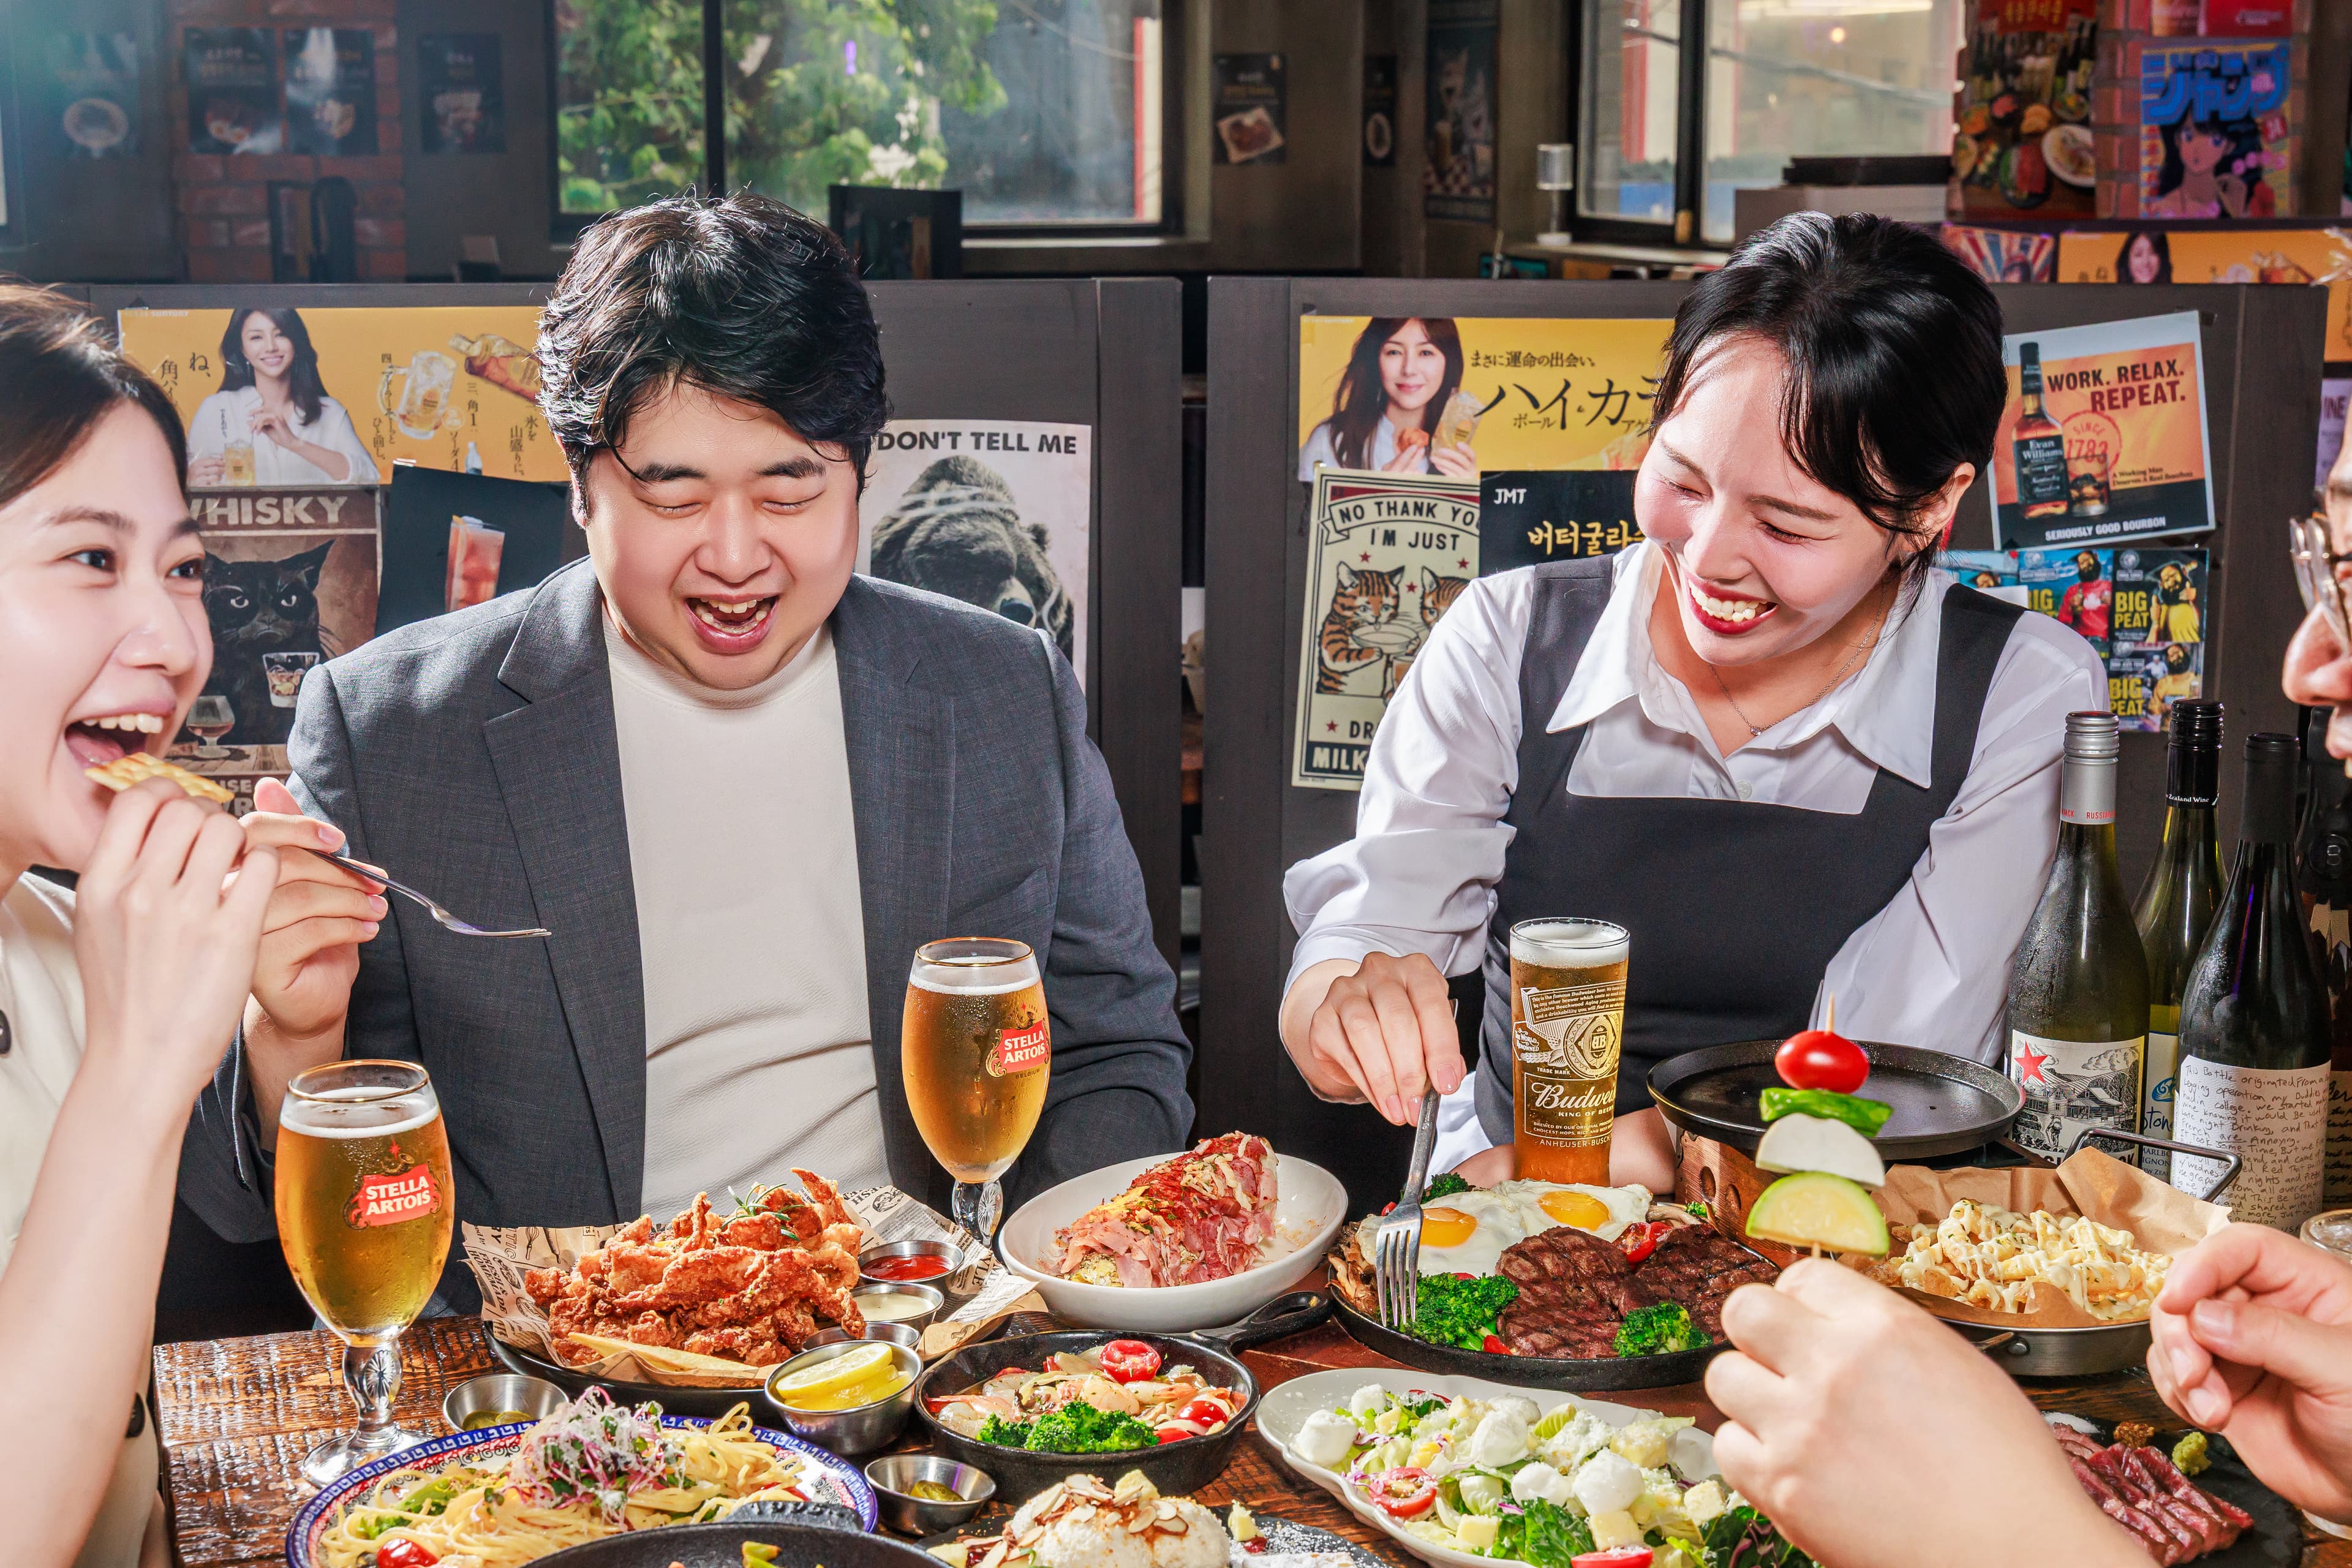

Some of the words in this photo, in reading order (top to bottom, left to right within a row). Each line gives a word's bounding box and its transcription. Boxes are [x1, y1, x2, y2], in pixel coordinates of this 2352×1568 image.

[1471, 350, 1596, 368] まさに運命の出会い。
[2047, 369, 2110, 393] WORK.
[2117, 358, 2184, 383] RELAX.
[2090, 380, 2185, 412] REPEAT.
[877, 431, 962, 451] DON'T
[970, 432, 1030, 452] TELL
[1038, 434, 1077, 454] ME
[2029, 439, 2056, 450] Evan
[2066, 438, 2108, 464] 1783
[2022, 447, 2063, 460] Williams
[1493, 488, 1527, 505] JMT
[1339, 505, 1365, 524] NO
[1374, 500, 1438, 519] THANK
[1451, 506, 1480, 531] YO
[2045, 526, 2094, 541] SERIOUSLY
[2095, 521, 2121, 535] GOOD
[2122, 516, 2166, 532] BOURBON
[1408, 531, 1460, 551] JUST
[2115, 590, 2147, 613] BIG
[2115, 612, 2150, 629] PEAT
[2108, 677, 2142, 699] BIG
[2110, 699, 2145, 716] PEAT
[1349, 720, 1379, 739] DR
[1312, 746, 1369, 772] MILK
[2168, 793, 2192, 802] Zealand
[1548, 1008, 1577, 1017] drinkability
[1005, 1030, 1044, 1050] STELLA
[1004, 1042, 1046, 1064] ARTOIS
[1015, 1068, 1041, 1079] BELGIUM
[2185, 1065, 2198, 1076] This
[2203, 1066, 2236, 1082] Bottle
[2216, 1087, 2266, 1102] operation
[2272, 1095, 2288, 1104] my
[2278, 1100, 2313, 1110] started
[2255, 1111, 2288, 1121] would
[2293, 1110, 2306, 1120] Be
[2199, 1117, 2226, 1131] night
[2281, 1121, 2301, 1133] and
[2247, 1144, 2277, 1157] Time,
[2301, 1142, 2314, 1151] we
[2271, 1155, 2291, 1164] and
[366, 1176, 429, 1200] STELLA
[2248, 1175, 2280, 1188] nights
[2285, 1172, 2302, 1183] and
[2260, 1185, 2275, 1195] all
[366, 1190, 431, 1216] ARTOIS
[2250, 1203, 2287, 1212] shared
[478, 1251, 505, 1287] FRESH
[467, 1250, 508, 1315] HOMEMADE
